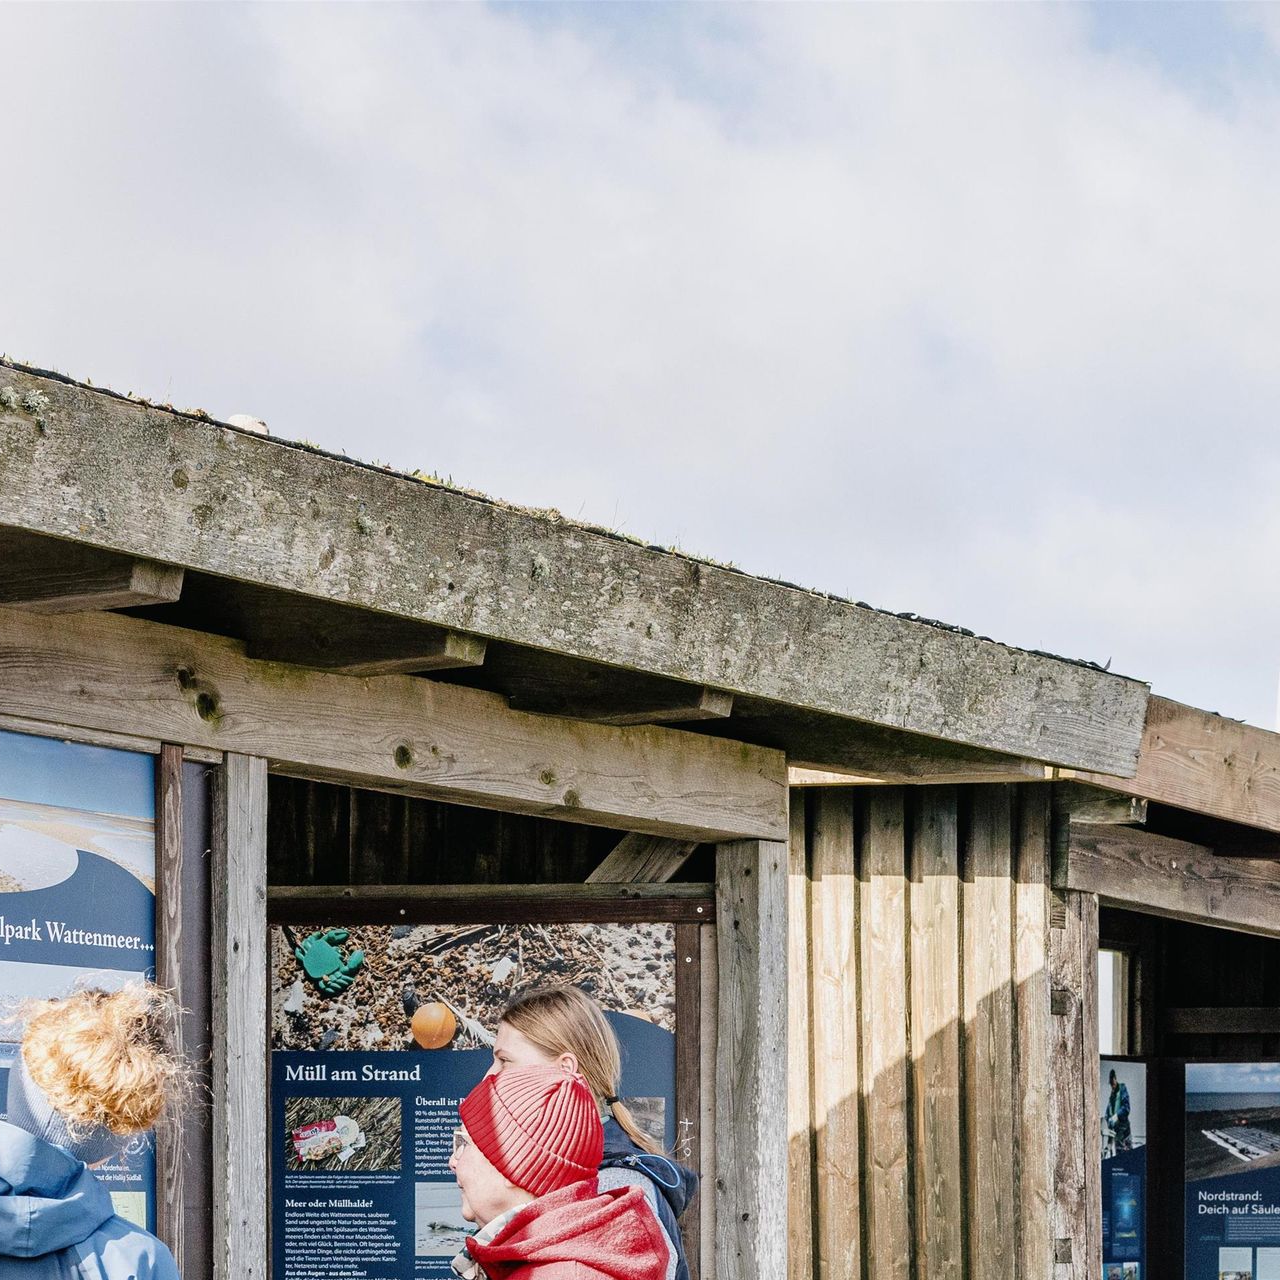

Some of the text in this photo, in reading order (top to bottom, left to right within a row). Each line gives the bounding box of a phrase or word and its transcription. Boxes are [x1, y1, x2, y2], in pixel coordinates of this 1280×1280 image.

[46, 920, 154, 950] Wattenmeer...
[285, 1064, 422, 1081] Müll am Strand
[415, 1096, 458, 1106] Überall ist
[1198, 1191, 1263, 1201] Nordstrand:
[285, 1200, 373, 1208] Meer oder Müllhalde?
[1198, 1204, 1229, 1215] Deich
[1232, 1204, 1248, 1215] auf
